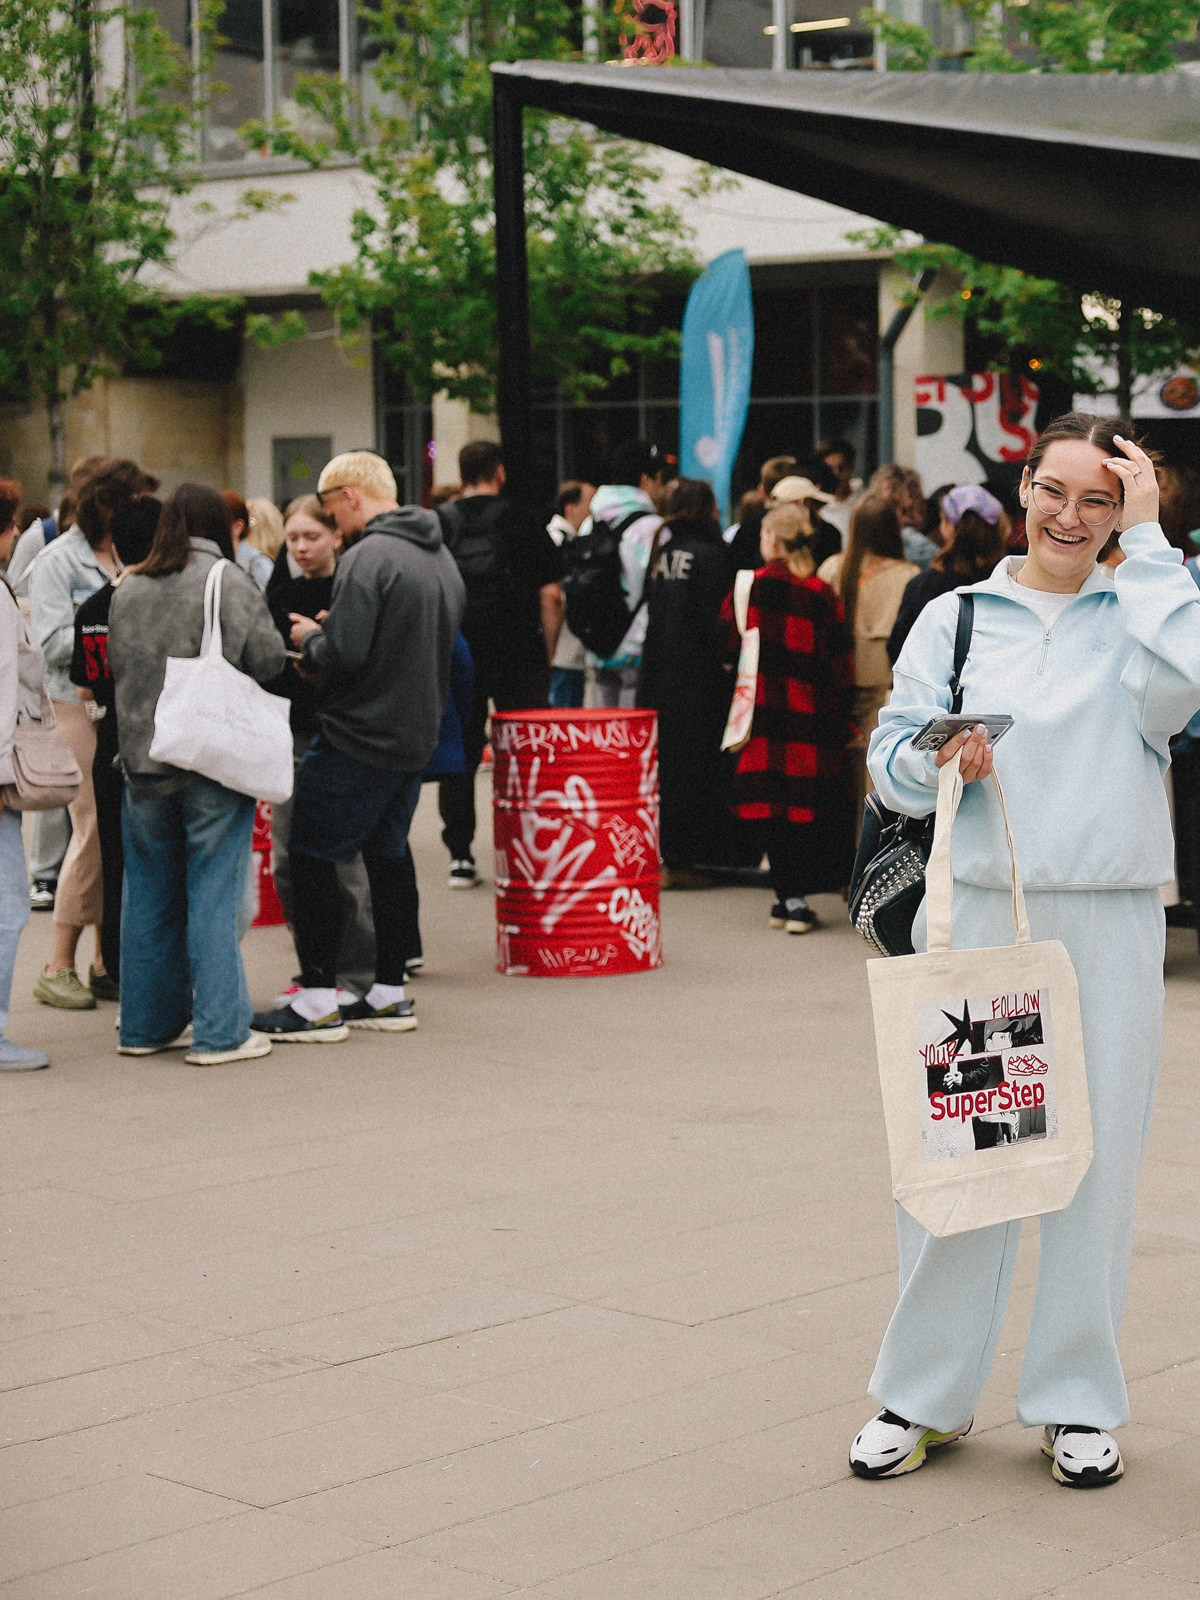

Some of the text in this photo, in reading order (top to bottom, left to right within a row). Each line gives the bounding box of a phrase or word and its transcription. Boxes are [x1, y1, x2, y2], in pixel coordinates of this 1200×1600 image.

[991, 989, 1040, 1019] FOLLOW
[919, 1040, 964, 1069] YOUR
[930, 1080, 1045, 1124] SuperStep
